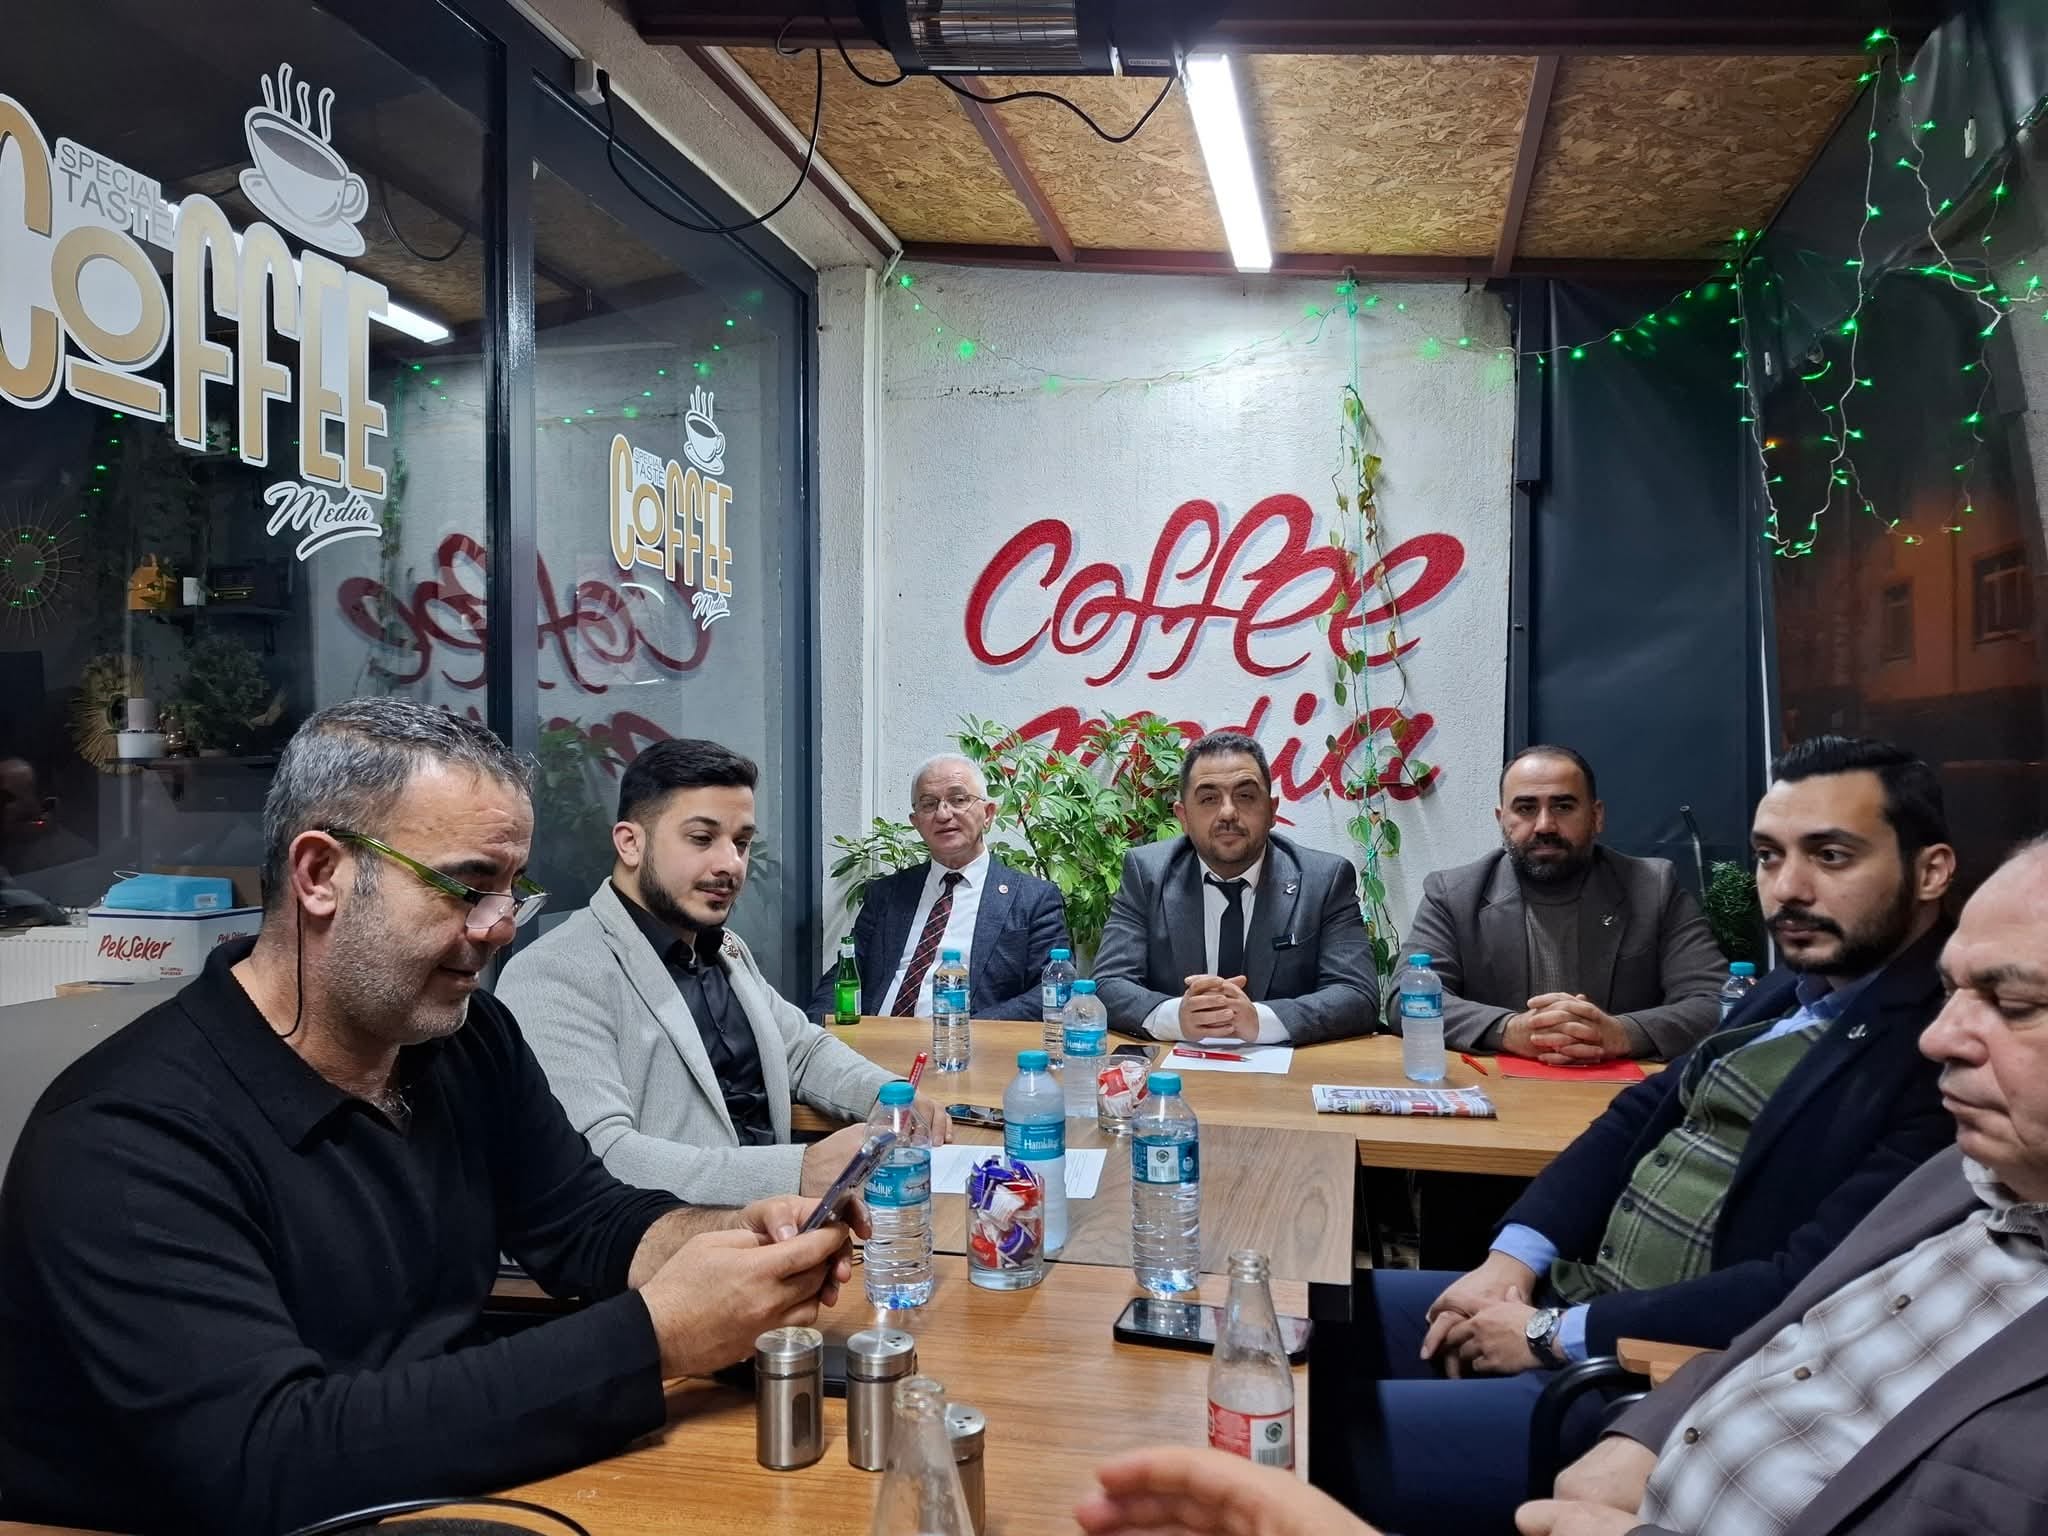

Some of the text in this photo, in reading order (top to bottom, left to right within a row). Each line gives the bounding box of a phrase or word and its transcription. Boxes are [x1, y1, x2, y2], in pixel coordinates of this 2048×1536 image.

[61, 144, 168, 209] SPECIAL
[59, 167, 172, 246] TASTE
[634, 449, 662, 470] SPECIAL
[634, 460, 665, 487] TASTE
[265, 482, 374, 535] Media
[692, 592, 728, 619] Media
[964, 493, 1466, 688] Coffee
